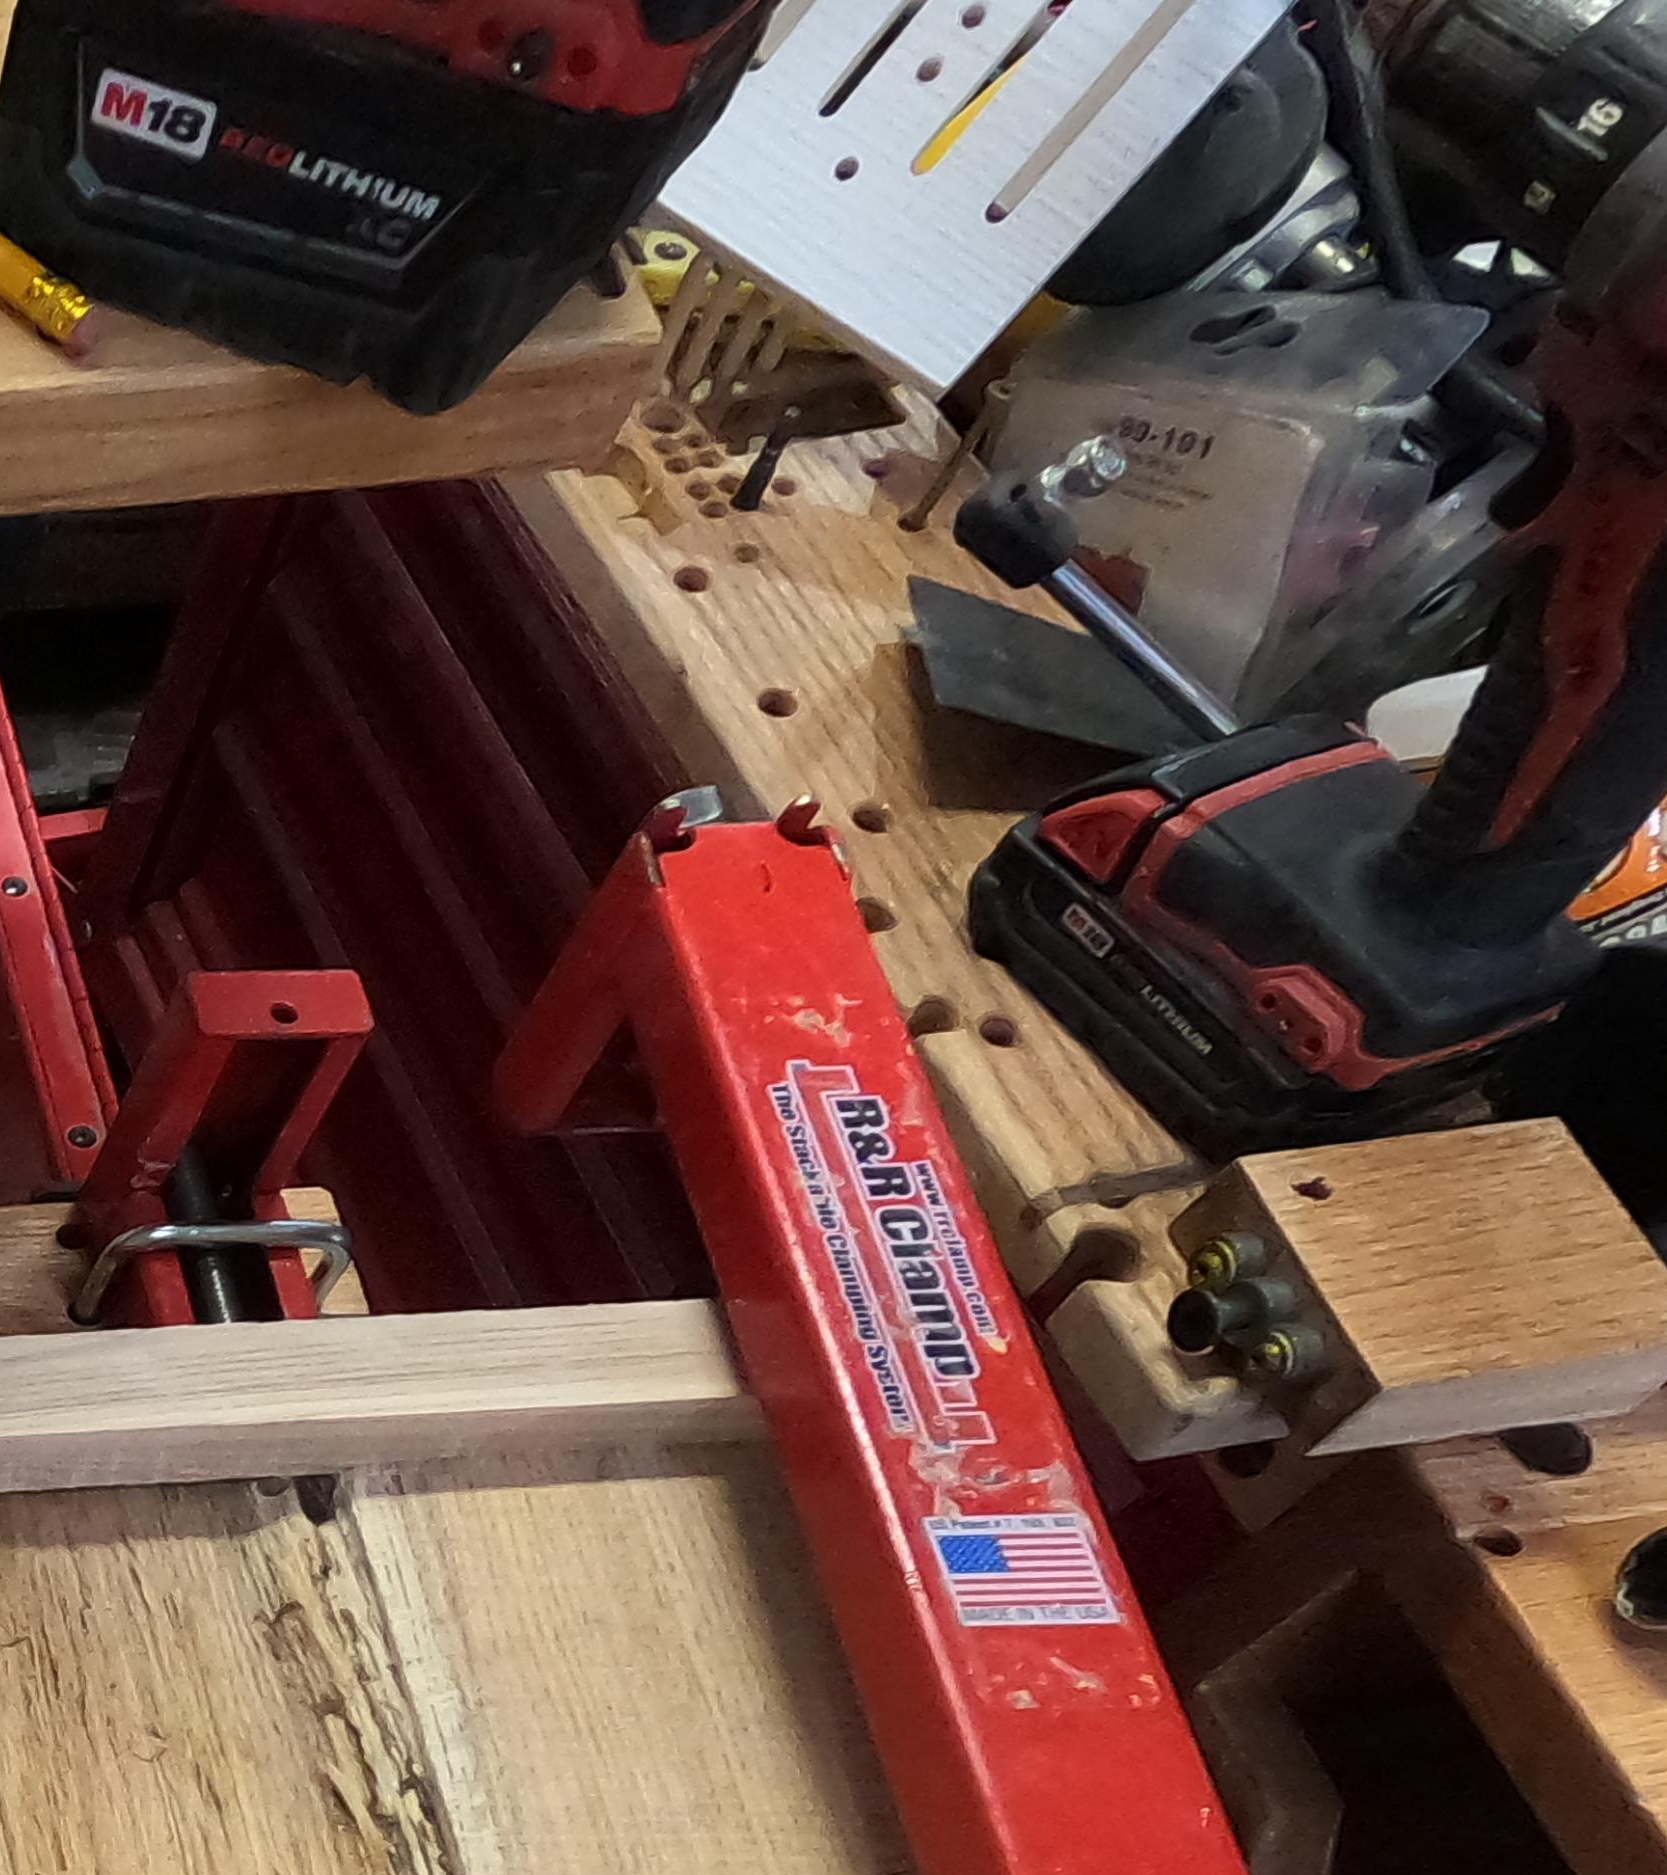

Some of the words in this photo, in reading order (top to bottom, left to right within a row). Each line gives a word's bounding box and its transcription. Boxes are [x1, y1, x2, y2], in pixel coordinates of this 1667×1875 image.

[100, 81, 207, 144] M18
[1577, 98, 1624, 137] 16
[834, 1097, 913, 1197] R&R
[878, 1208, 976, 1377] Clamp
